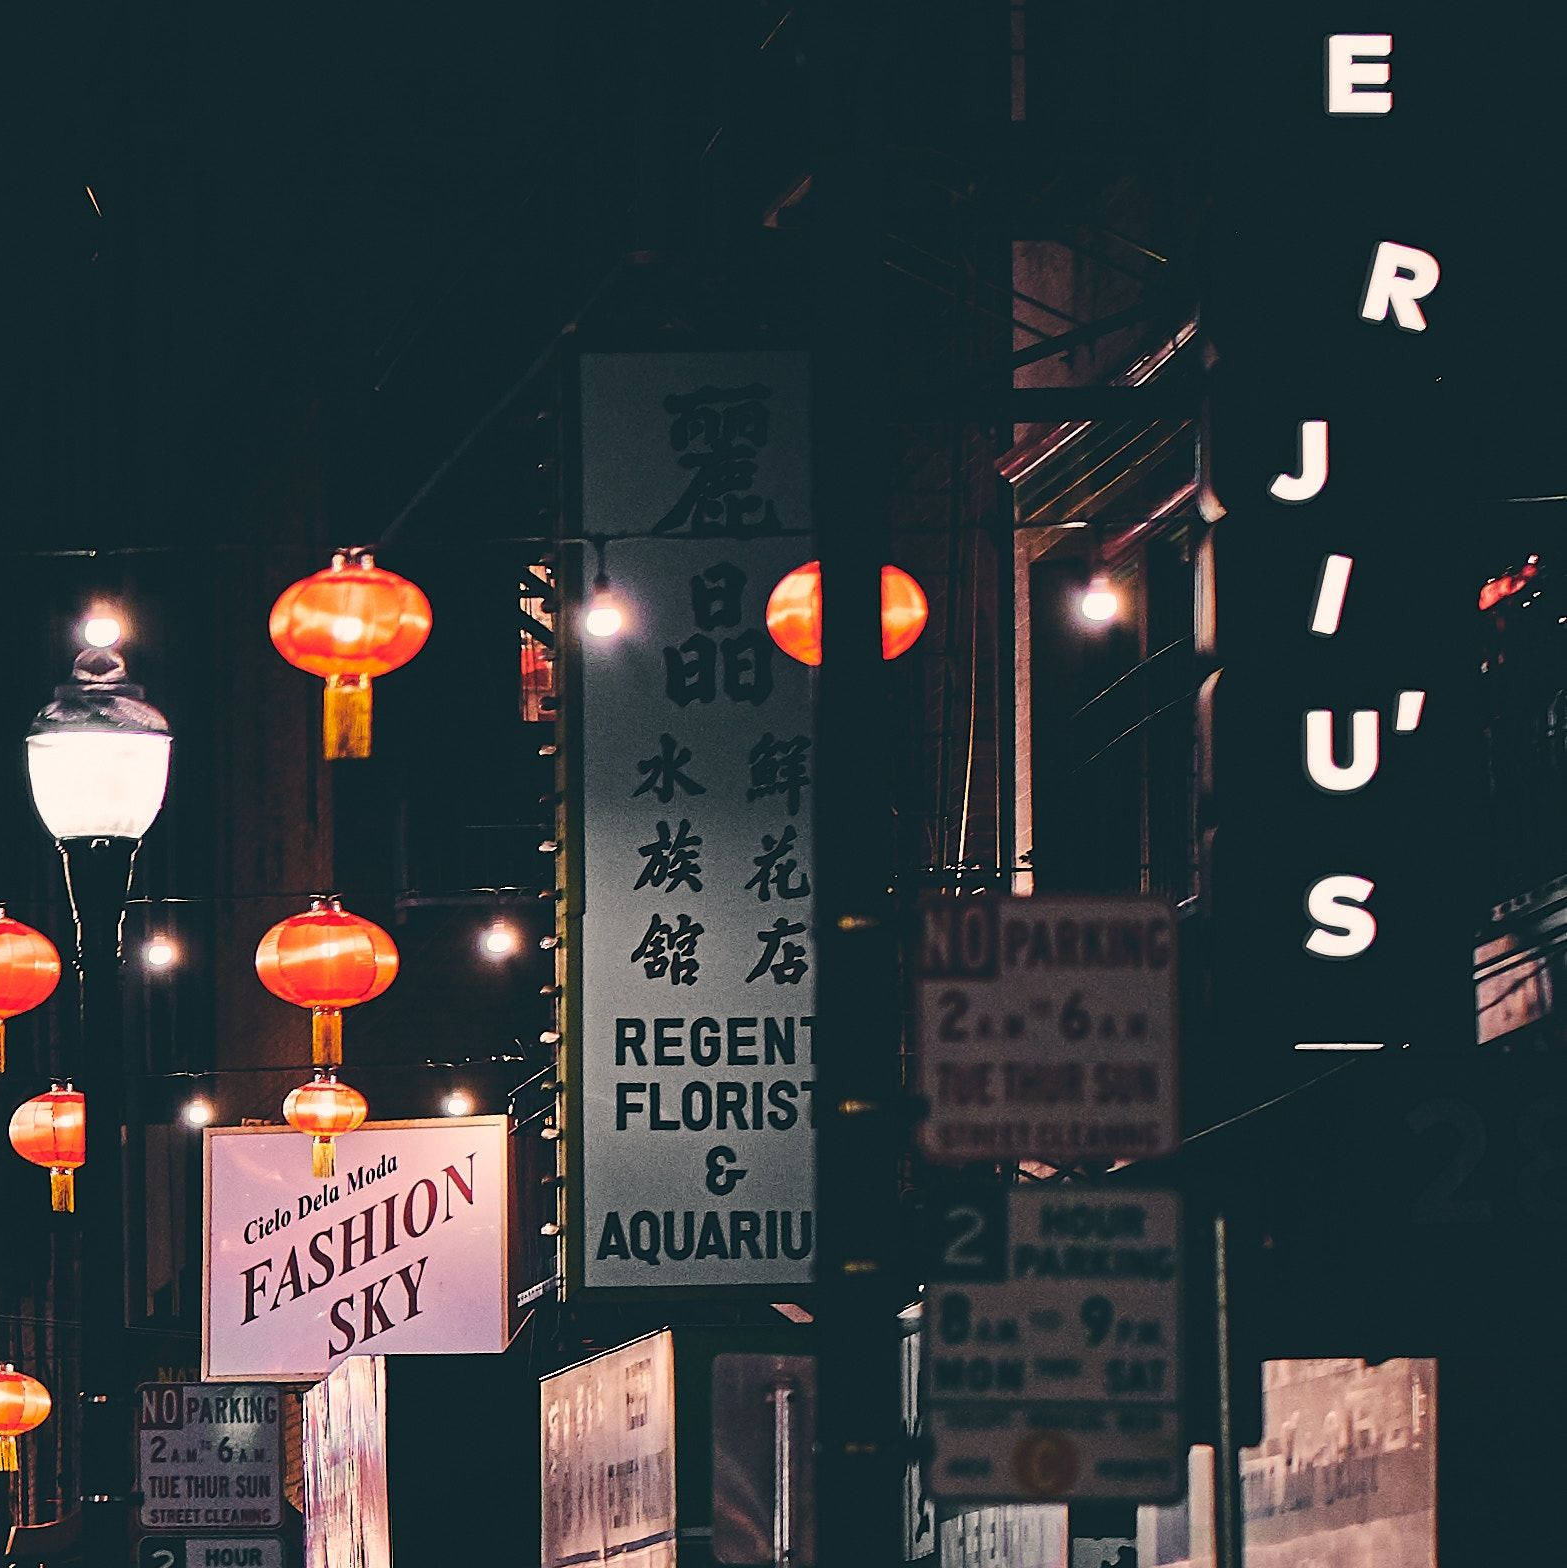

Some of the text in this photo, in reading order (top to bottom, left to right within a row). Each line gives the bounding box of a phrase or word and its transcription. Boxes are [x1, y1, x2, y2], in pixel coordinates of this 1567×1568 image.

[653, 383, 783, 706] 麗晶
[706, 1144, 747, 1196] &
[243, 1153, 399, 1245] Cielo Dela Moda
[239, 1151, 478, 1326] FASHION
[944, 1205, 987, 1265] 2
[328, 1255, 429, 1360] SKY
[142, 1389, 277, 1424] NO PARKING
[150, 1435, 167, 1463] 2
[218, 1436, 233, 1463] 6
[148, 1475, 271, 1498] TUE THUR SUN
[150, 1508, 271, 1523] STREET CLEANING
[205, 1548, 262, 1567] HOUR
